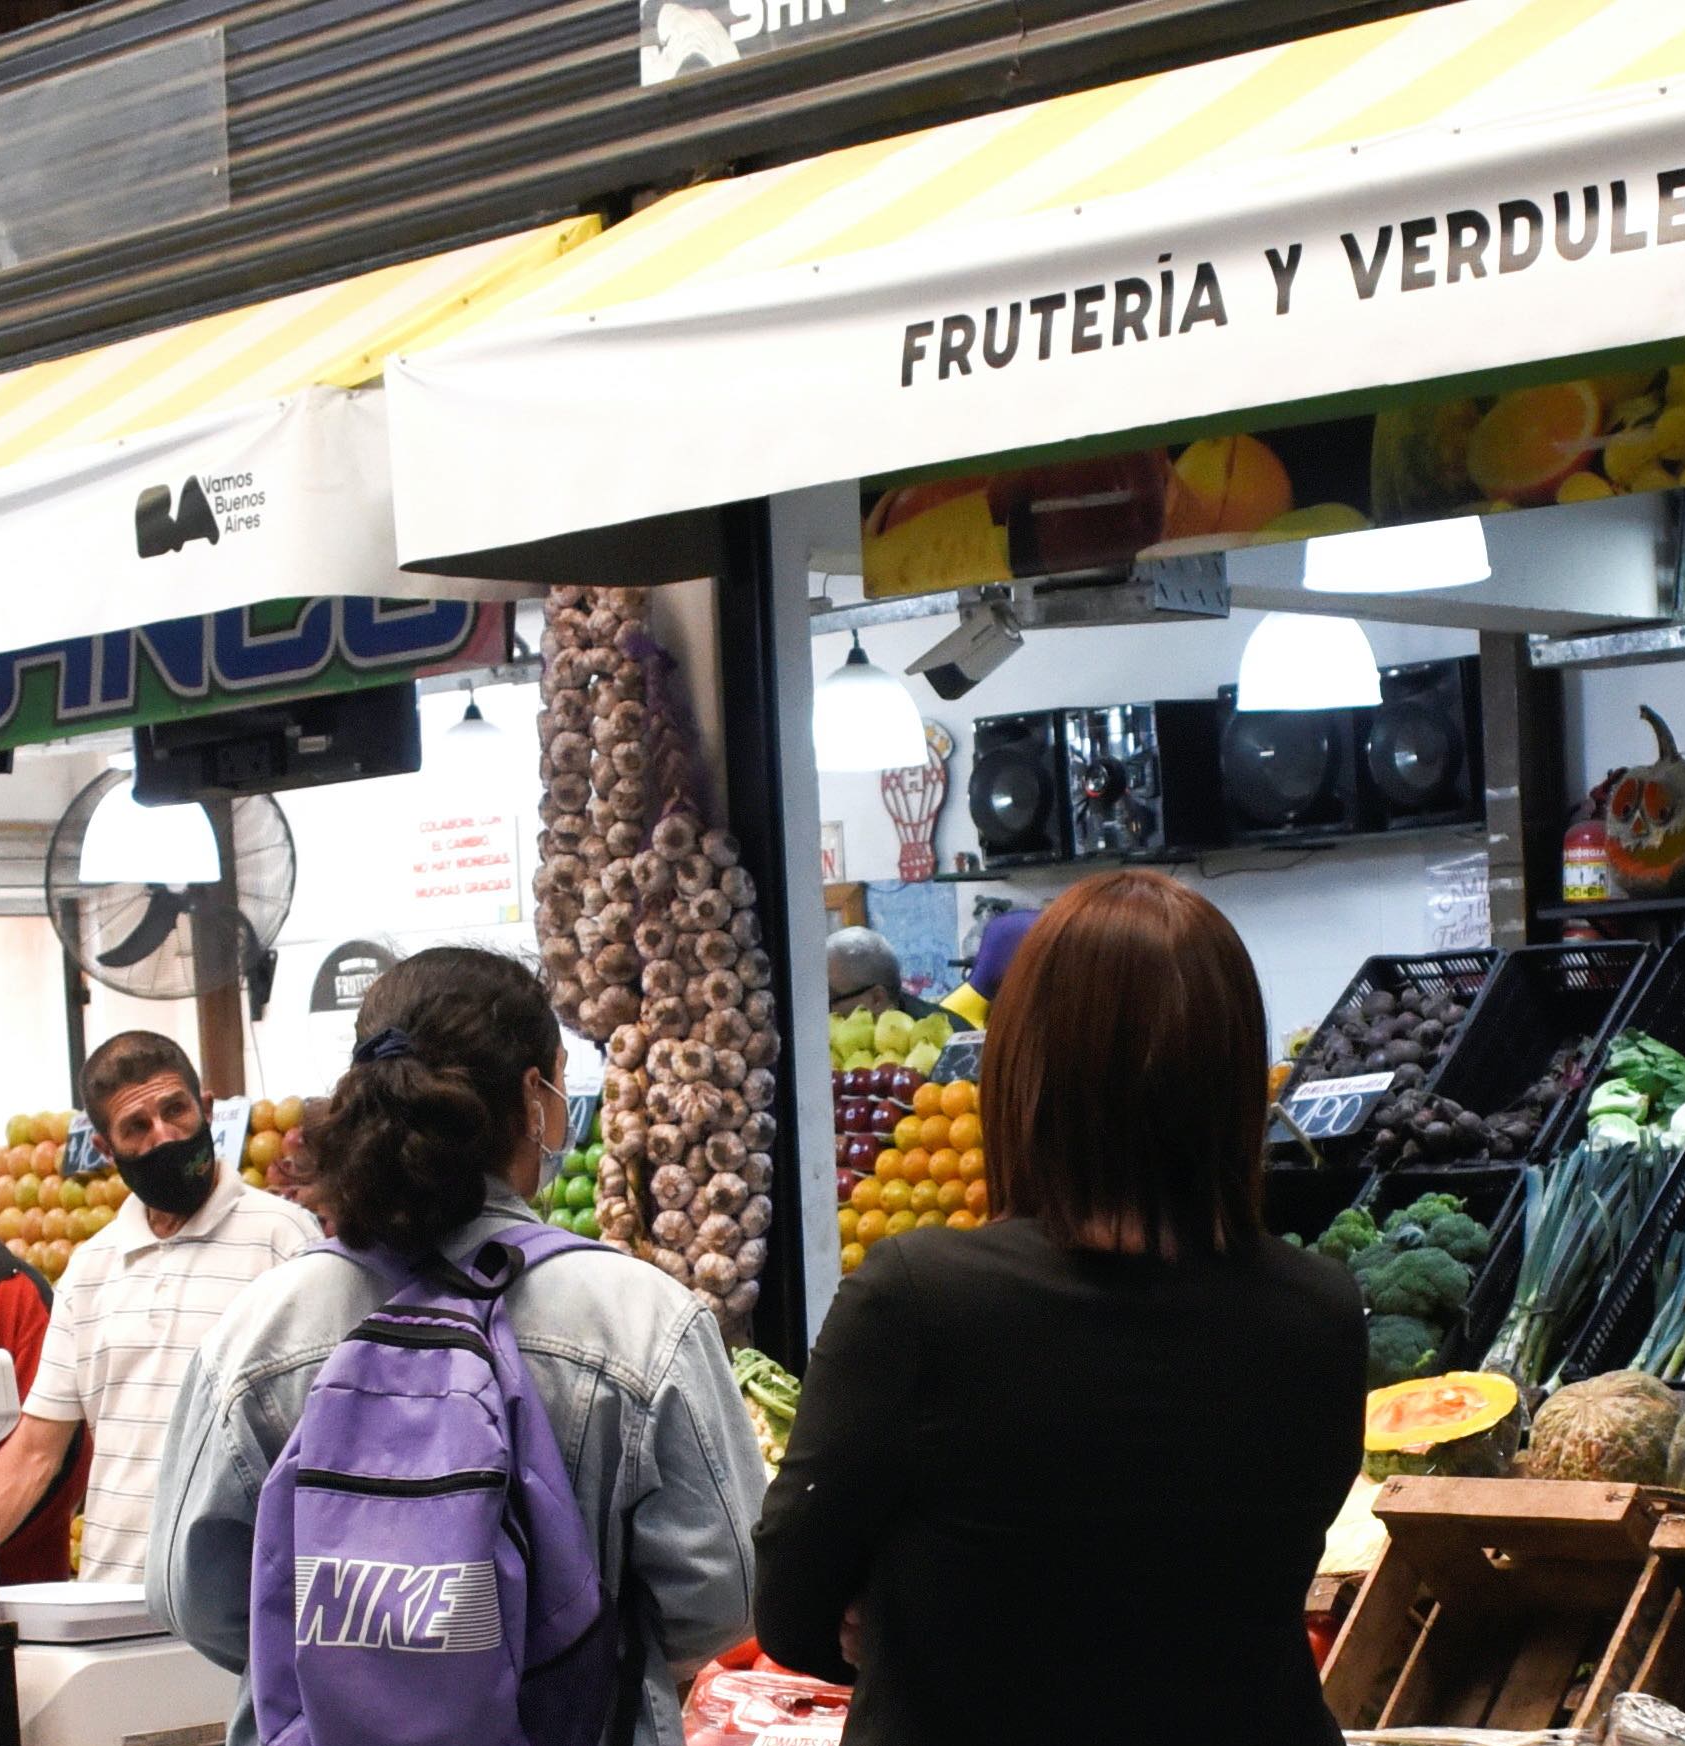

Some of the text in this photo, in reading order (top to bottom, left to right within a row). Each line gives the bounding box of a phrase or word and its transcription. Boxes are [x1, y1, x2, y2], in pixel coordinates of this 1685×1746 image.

[900, 252, 1228, 388] FRUTERÍA
[1264, 243, 1303, 316] Y
[202, 472, 253, 494] Vamos
[215, 491, 265, 514] Buenos
[225, 514, 260, 534] Aires
[295, 1557, 465, 1652] NIKE
